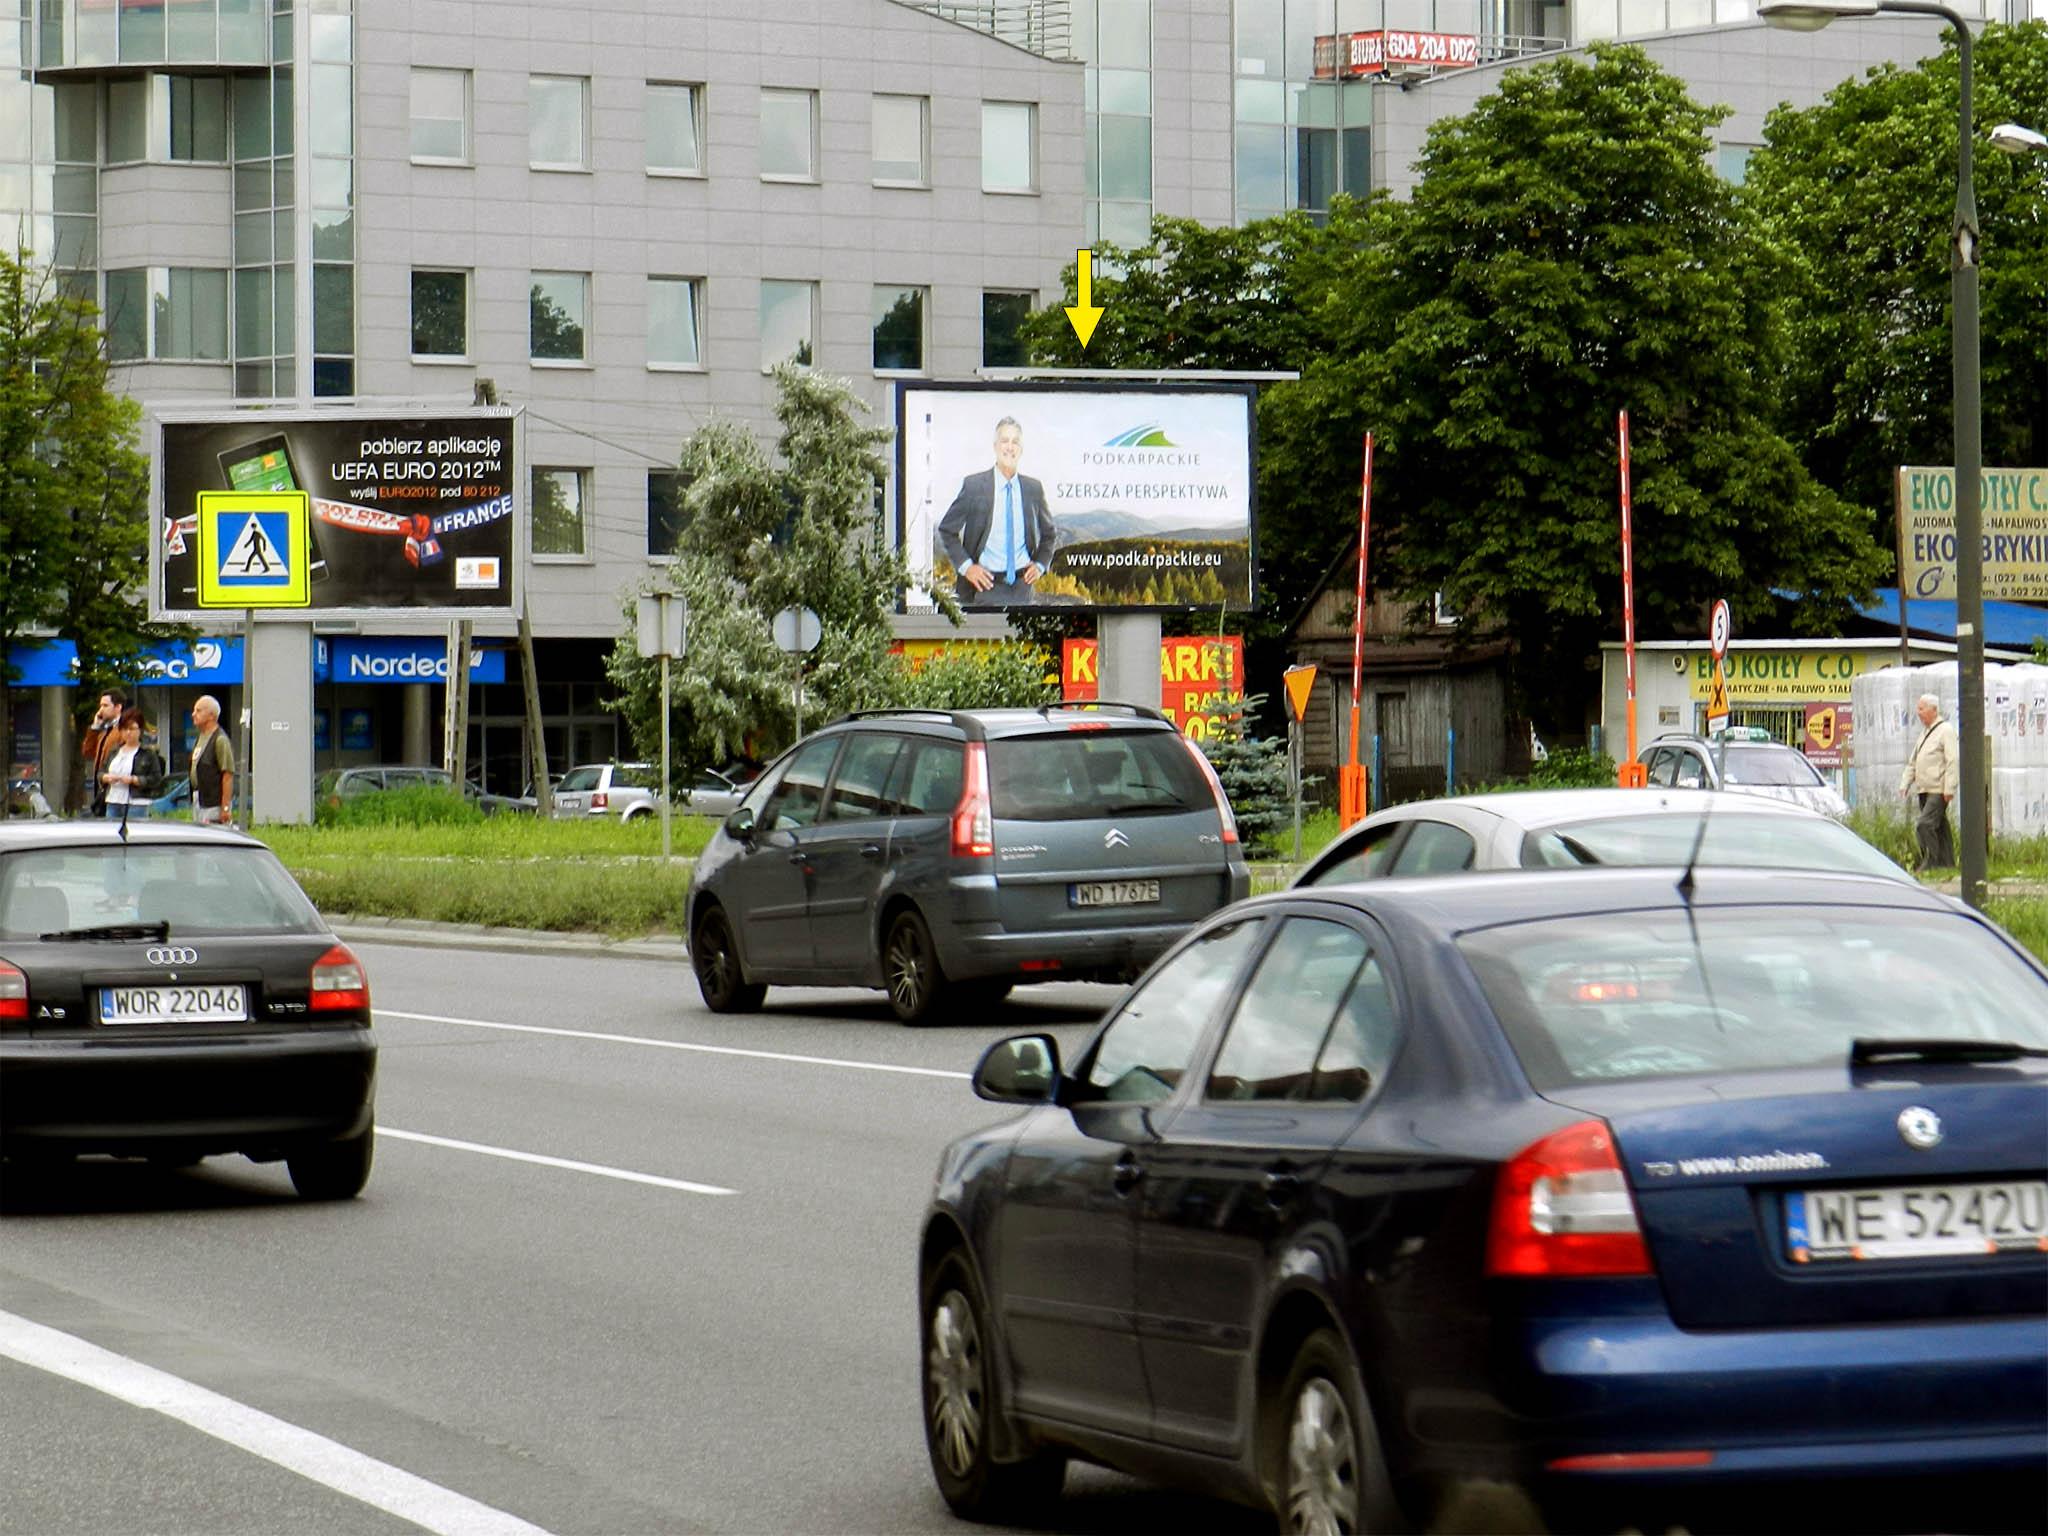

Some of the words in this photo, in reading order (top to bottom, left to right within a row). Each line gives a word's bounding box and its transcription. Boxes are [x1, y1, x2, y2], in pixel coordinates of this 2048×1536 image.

[1351, 38, 1382, 65] BIURA
[1389, 33, 1416, 59] 604
[1419, 36, 1446, 61] 204
[1450, 38, 1476, 63] 002
[360, 438, 423, 458] pobierz
[427, 436, 501, 457] aplikację
[1083, 453, 1201, 465] PODKARPACKIE
[332, 463, 379, 480] UEFA
[383, 462, 436, 480] EURO
[350, 486, 377, 500] wyślij
[379, 487, 437, 498] EURO2012
[440, 485, 462, 499] pod
[480, 486, 501, 497] 212
[1056, 484, 1120, 499] SZERSZA
[1125, 484, 1229, 499] PERSPEKTYWA
[1911, 474, 1953, 510] EKO
[1980, 476, 2022, 511] TŁY
[443, 495, 513, 532] FRANCE
[1066, 550, 1222, 569] www.podkarpackie.eu
[1914, 534, 1957, 561] EKO
[1717, 615, 1723, 641] 5
[1742, 655, 1804, 679] KOTŁY
[1698, 684, 1770, 693] AUMATYCZNE
[1791, 684, 1826, 694] PALIWO
[115, 988, 161, 1015] WOR
[169, 986, 240, 1014] 22046
[1815, 1193, 1886, 1244] WE
[1901, 1181, 2047, 1241] 5242U
